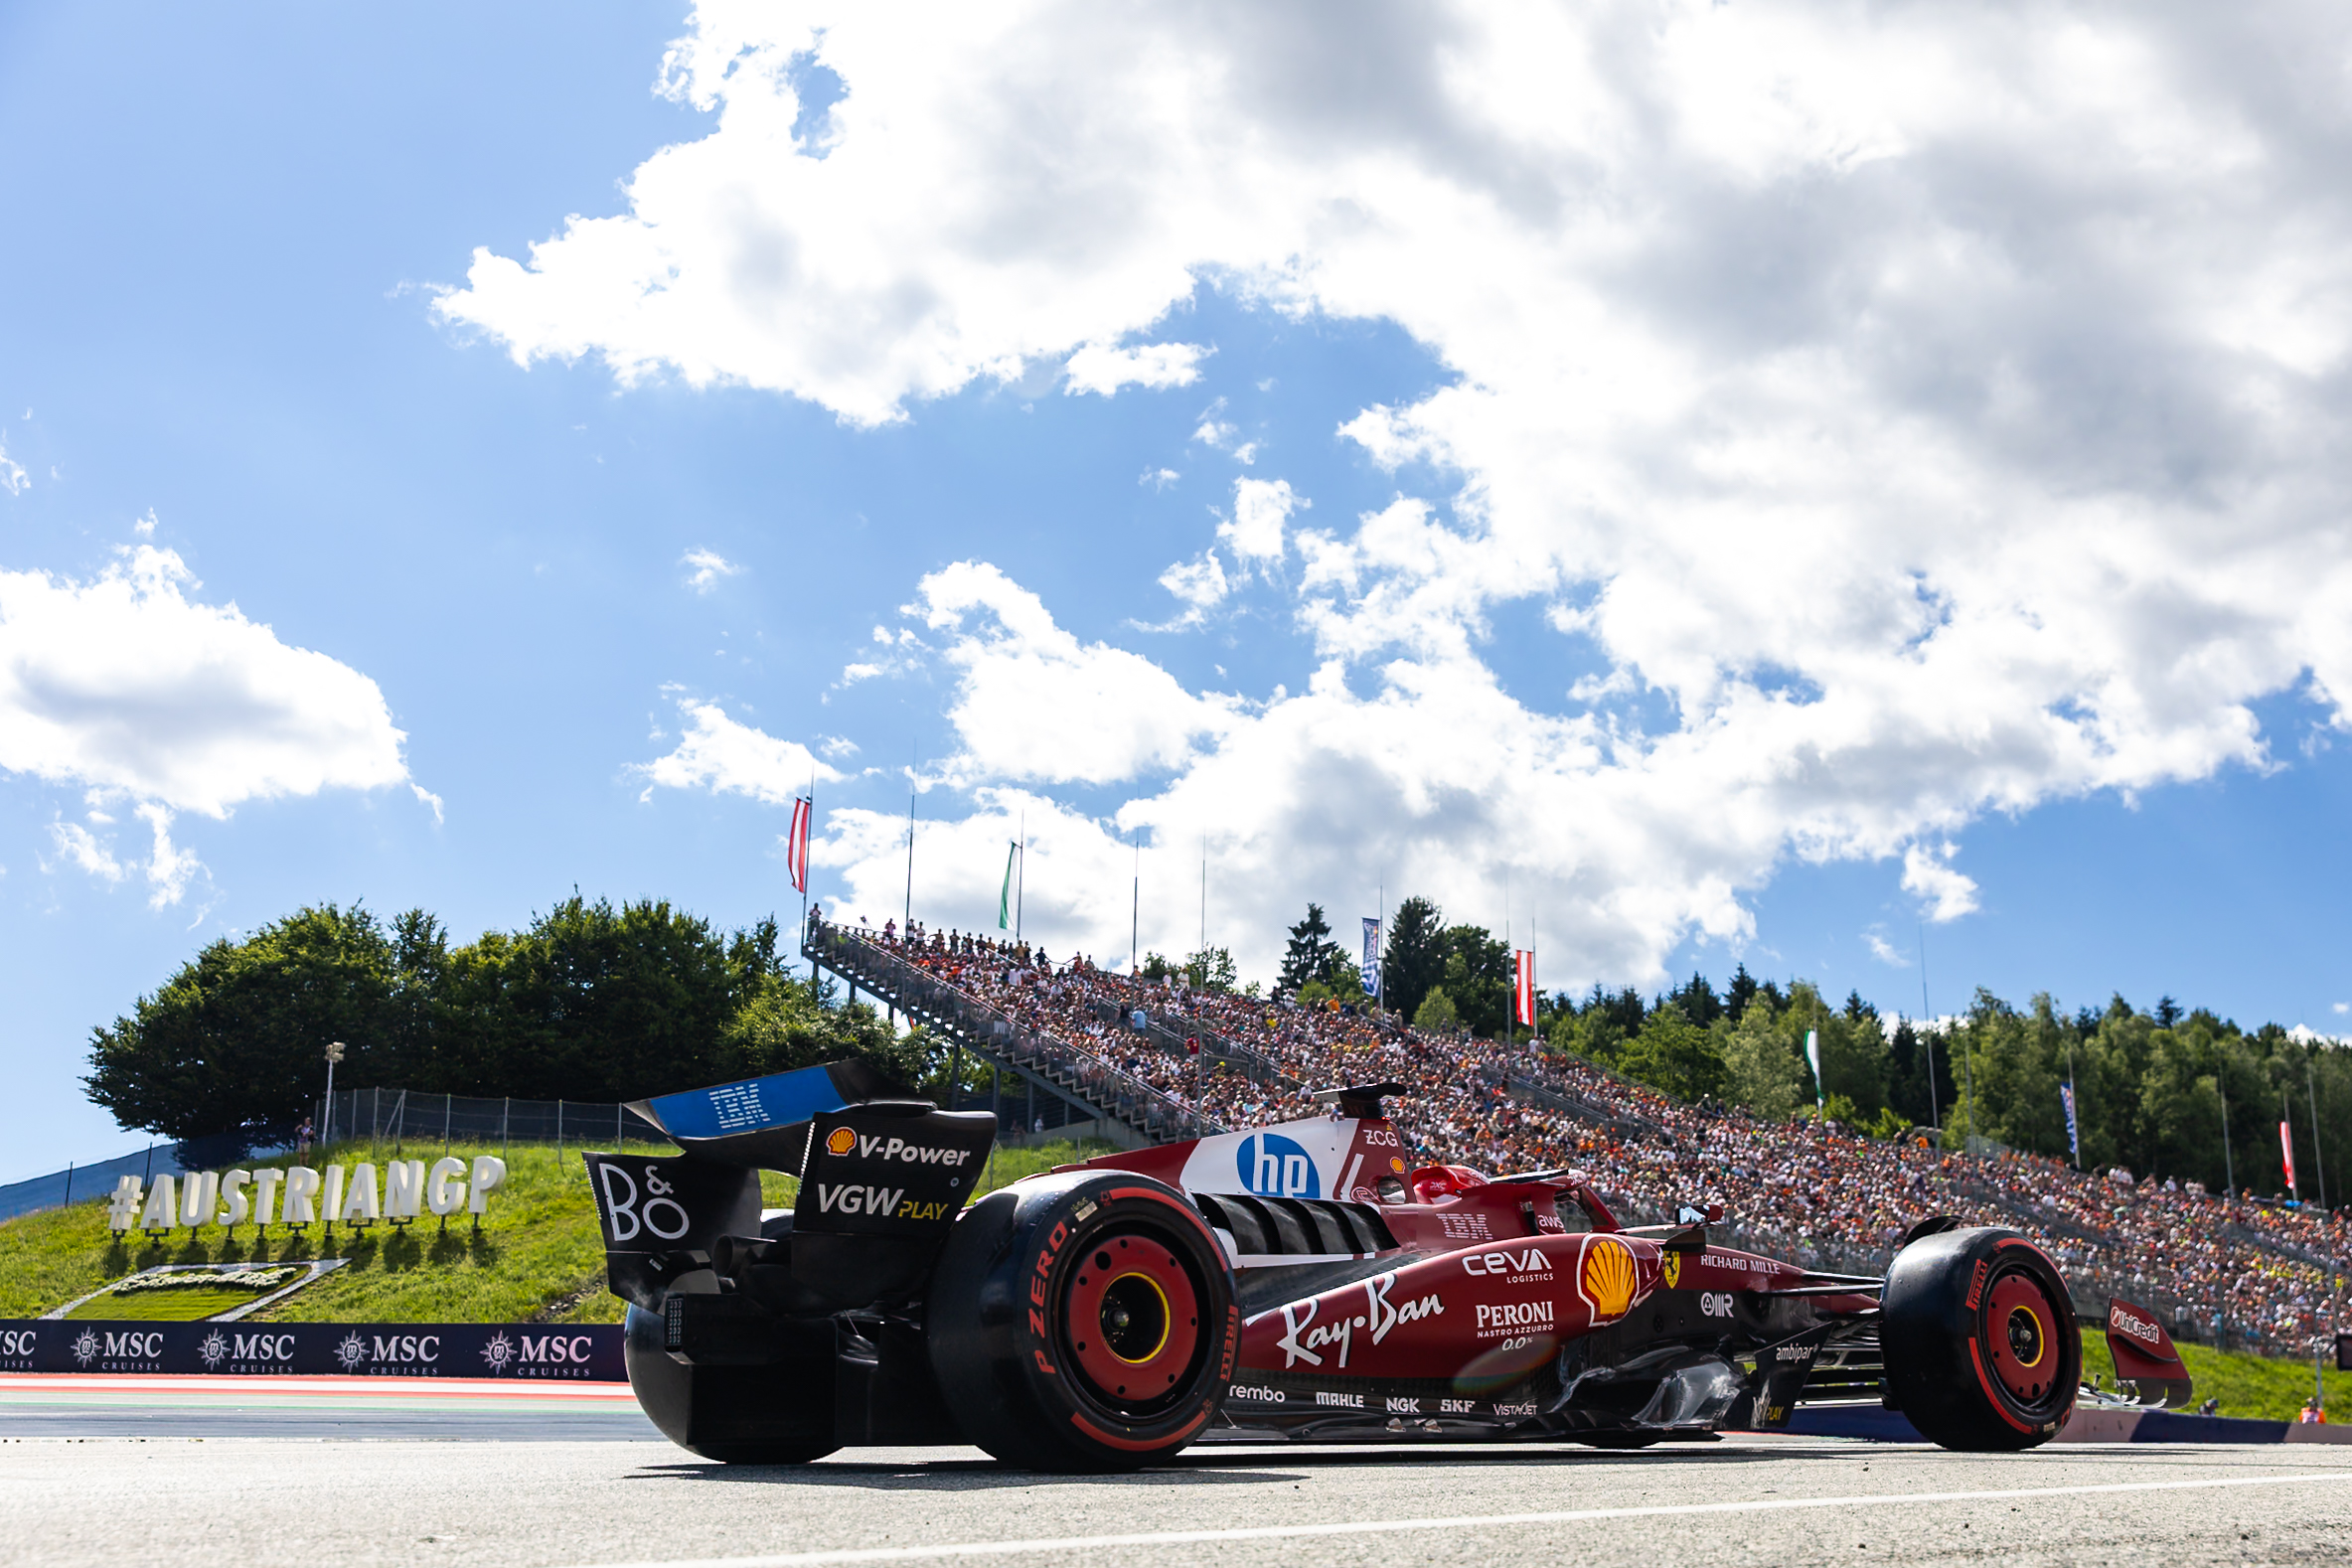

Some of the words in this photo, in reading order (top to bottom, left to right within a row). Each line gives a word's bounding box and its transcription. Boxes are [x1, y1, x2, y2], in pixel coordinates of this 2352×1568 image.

[708, 1083, 771, 1129] IBM
[860, 1135, 971, 1167] V-Power
[1253, 1134, 1309, 1199] hp
[107, 1156, 507, 1230] #AUSTRIANGP
[818, 1183, 904, 1216] VGW
[898, 1200, 949, 1220] PLAY
[1436, 1213, 1493, 1239] IBM
[1537, 1214, 1565, 1231] aws
[1700, 1254, 1747, 1271] RICHARD
[1750, 1260, 1781, 1274] MILLE
[1028, 1221, 1068, 1338] ZERO
[1506, 1273, 1554, 1284] LOGISTICS
[1476, 1301, 1555, 1328] PERONI
[1477, 1328, 1512, 1338] NASTRO
[1513, 1324, 1554, 1335] AZZURRO
[2119, 1311, 2159, 1344] UniCredit
[0, 1331, 37, 1356] SC
[103, 1332, 164, 1357] MSC
[232, 1333, 295, 1360] MSC
[371, 1335, 440, 1362] MSC
[519, 1335, 592, 1363] MSC
[1501, 1336, 1533, 1351] 0.0%
[1776, 1342, 1813, 1363] ambipar
[102, 1361, 161, 1370] CRUISES
[230, 1363, 293, 1373] CRUISES
[370, 1366, 438, 1375] CRUISES
[518, 1367, 590, 1377] CRUISES
[1034, 1349, 1056, 1373] P
[1229, 1385, 1286, 1403] rembo
[1316, 1391, 1364, 1408] MAHLE
[1386, 1397, 1421, 1414] NGK
[1441, 1398, 1476, 1413] SKF
